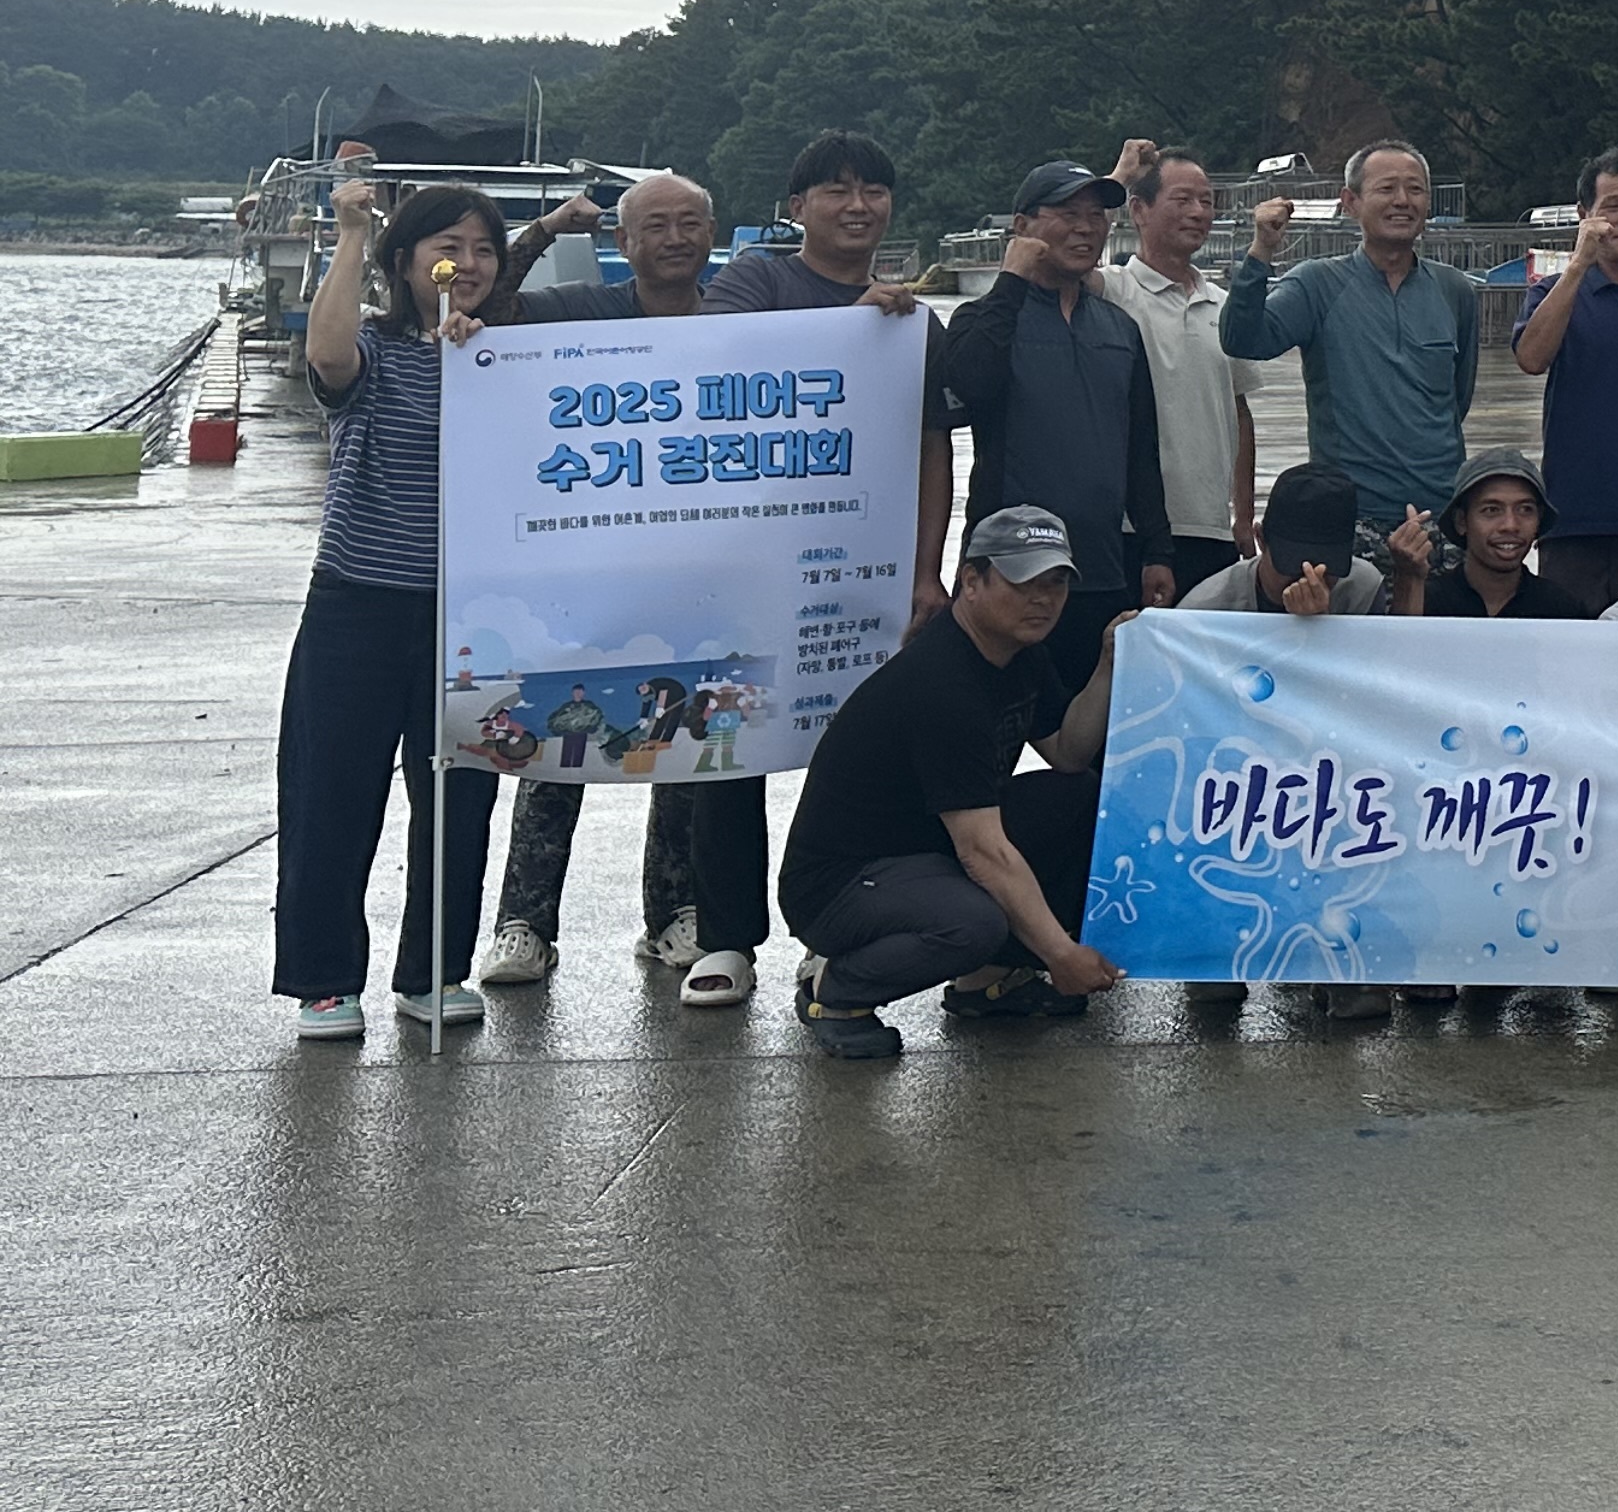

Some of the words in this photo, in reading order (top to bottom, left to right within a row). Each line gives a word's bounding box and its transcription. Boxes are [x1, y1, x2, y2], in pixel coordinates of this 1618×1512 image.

[548, 379, 682, 428] 2025
[695, 369, 845, 422] 폐어구
[537, 438, 643, 492] 수거
[658, 428, 853, 483] 경진대회
[802, 569, 820, 585] 7월
[823, 568, 841, 583] 7일
[855, 565, 872, 580] 7월
[875, 562, 897, 577] 16일
[792, 716, 811, 730] 7월
[1202, 758, 1400, 862] 바다도
[1423, 771, 1592, 872] 깨끗!
